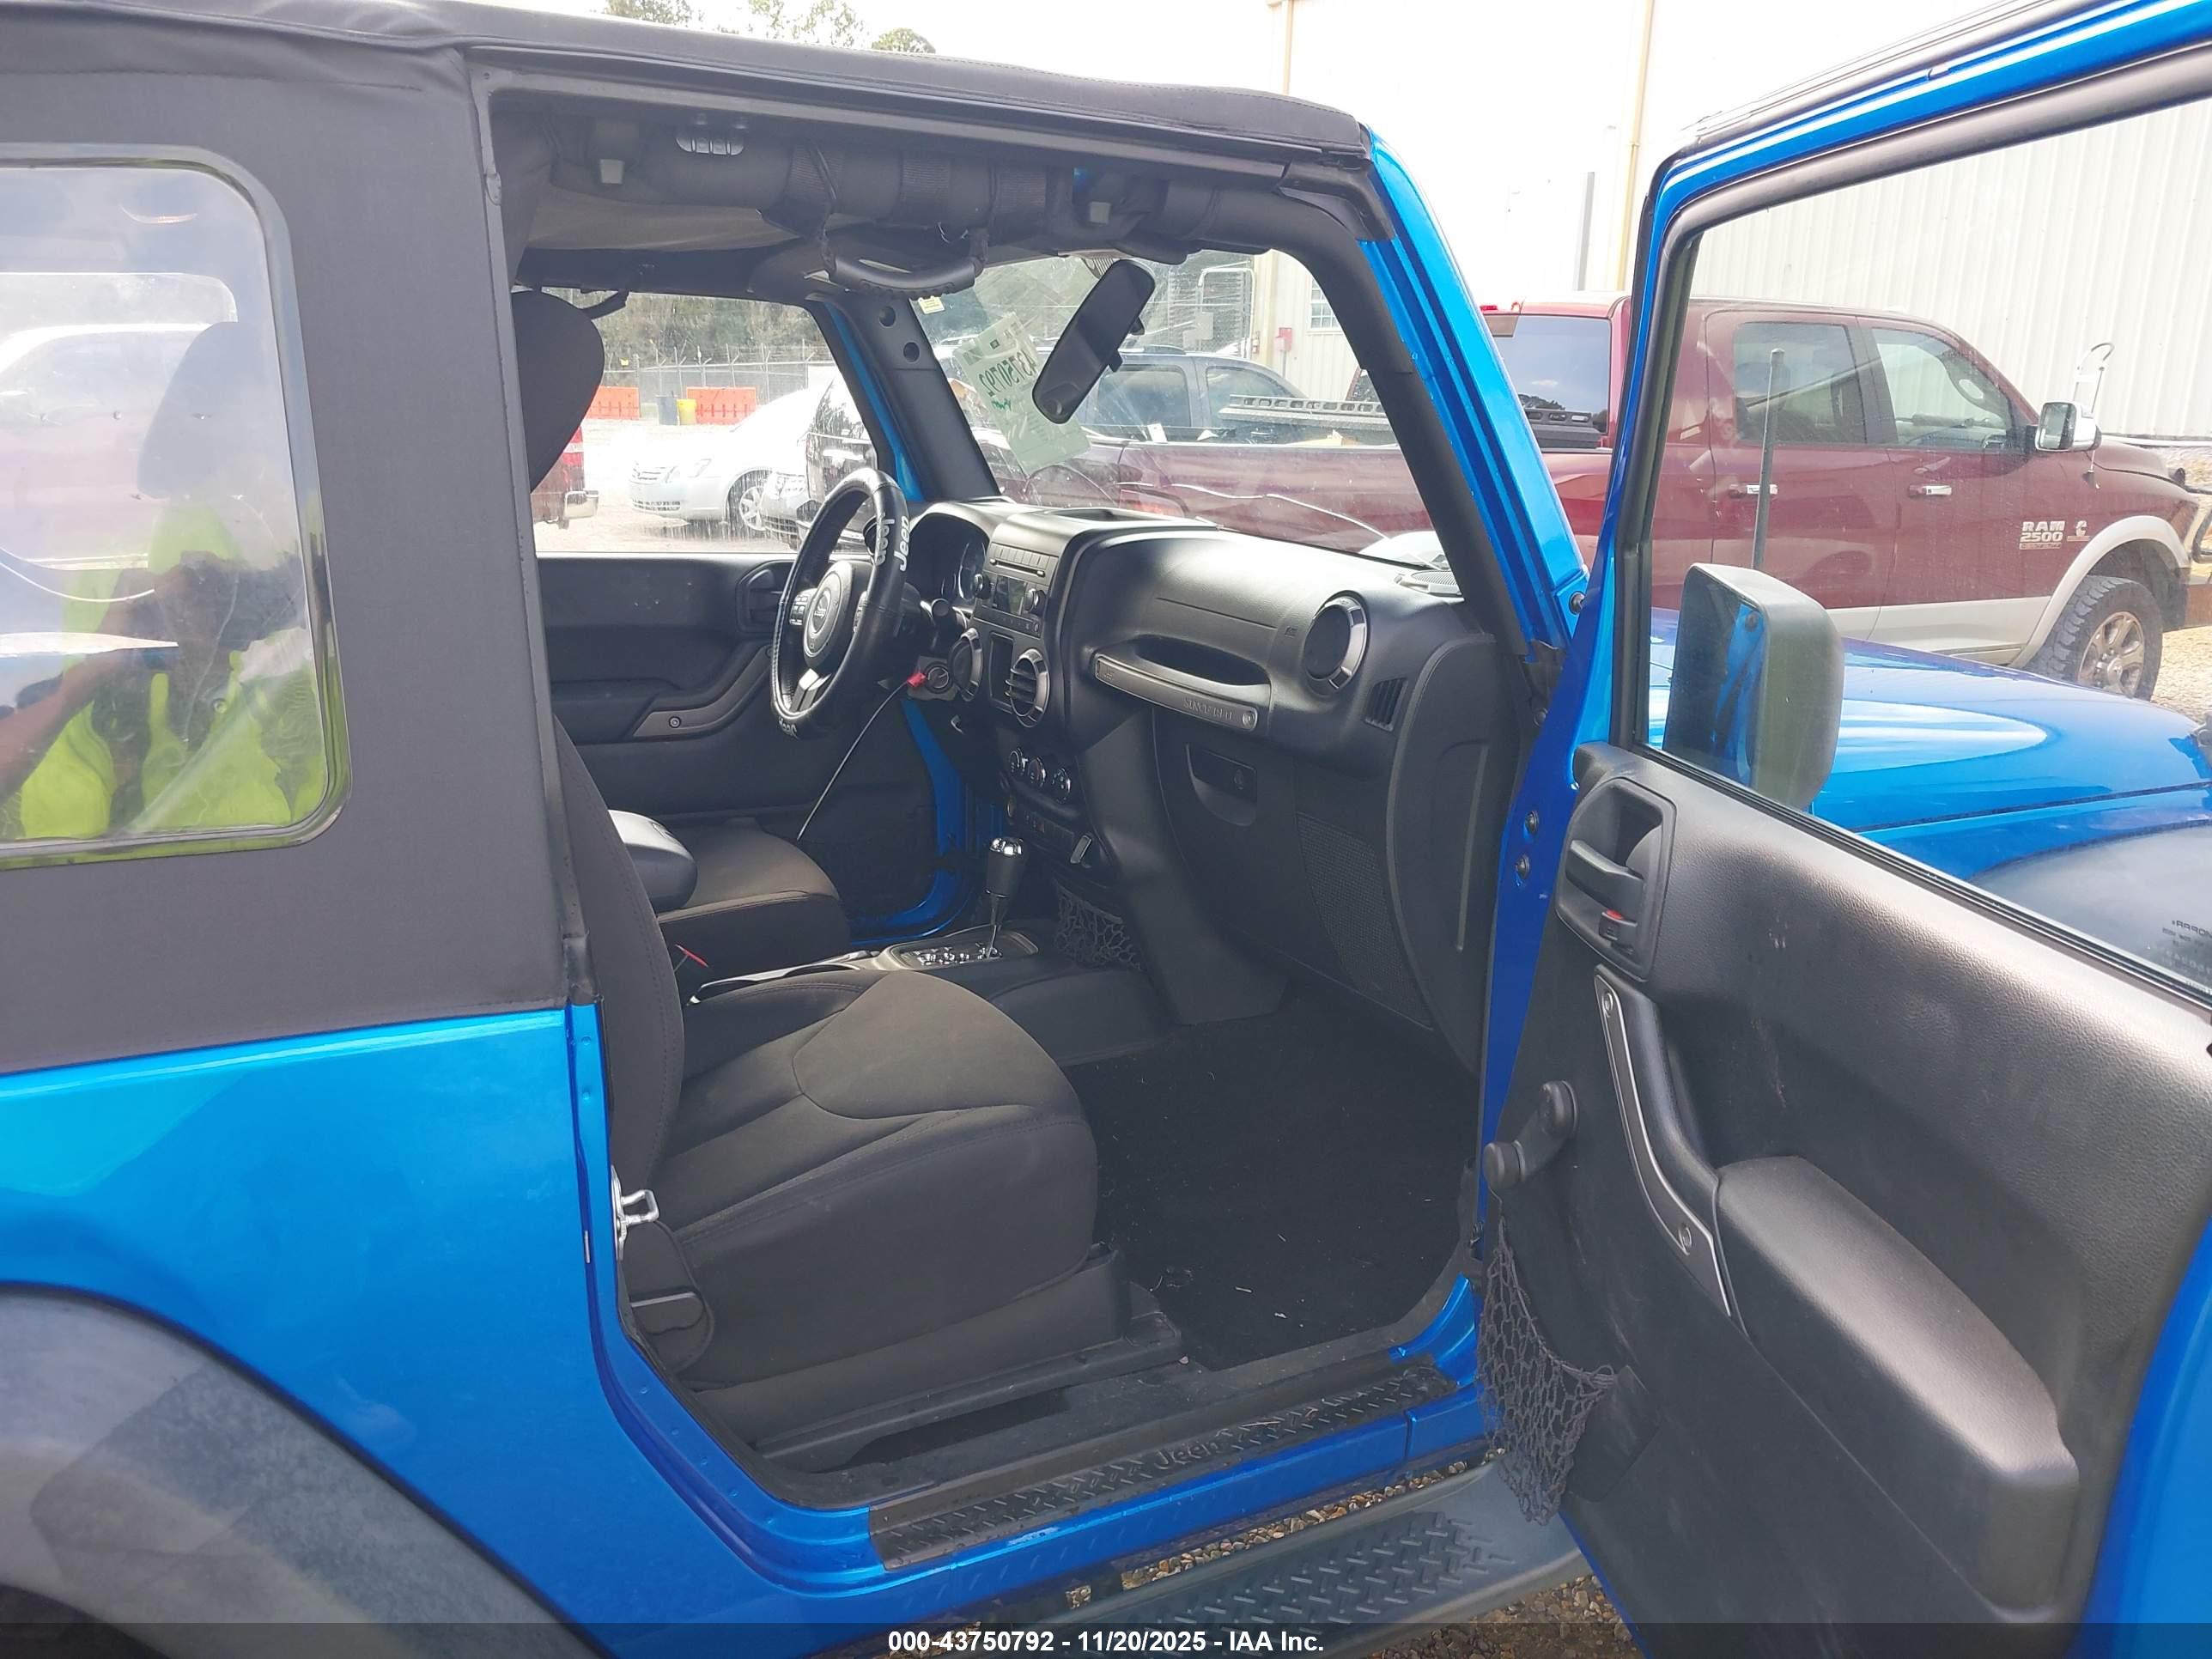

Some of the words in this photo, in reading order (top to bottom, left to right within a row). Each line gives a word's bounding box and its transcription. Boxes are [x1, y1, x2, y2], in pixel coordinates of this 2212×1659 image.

[2021, 520, 2065, 532] RAM
[893, 515, 910, 572] Jeep
[2020, 532, 2063, 542] 2500
[1154, 1441, 1220, 1469] Jeep
